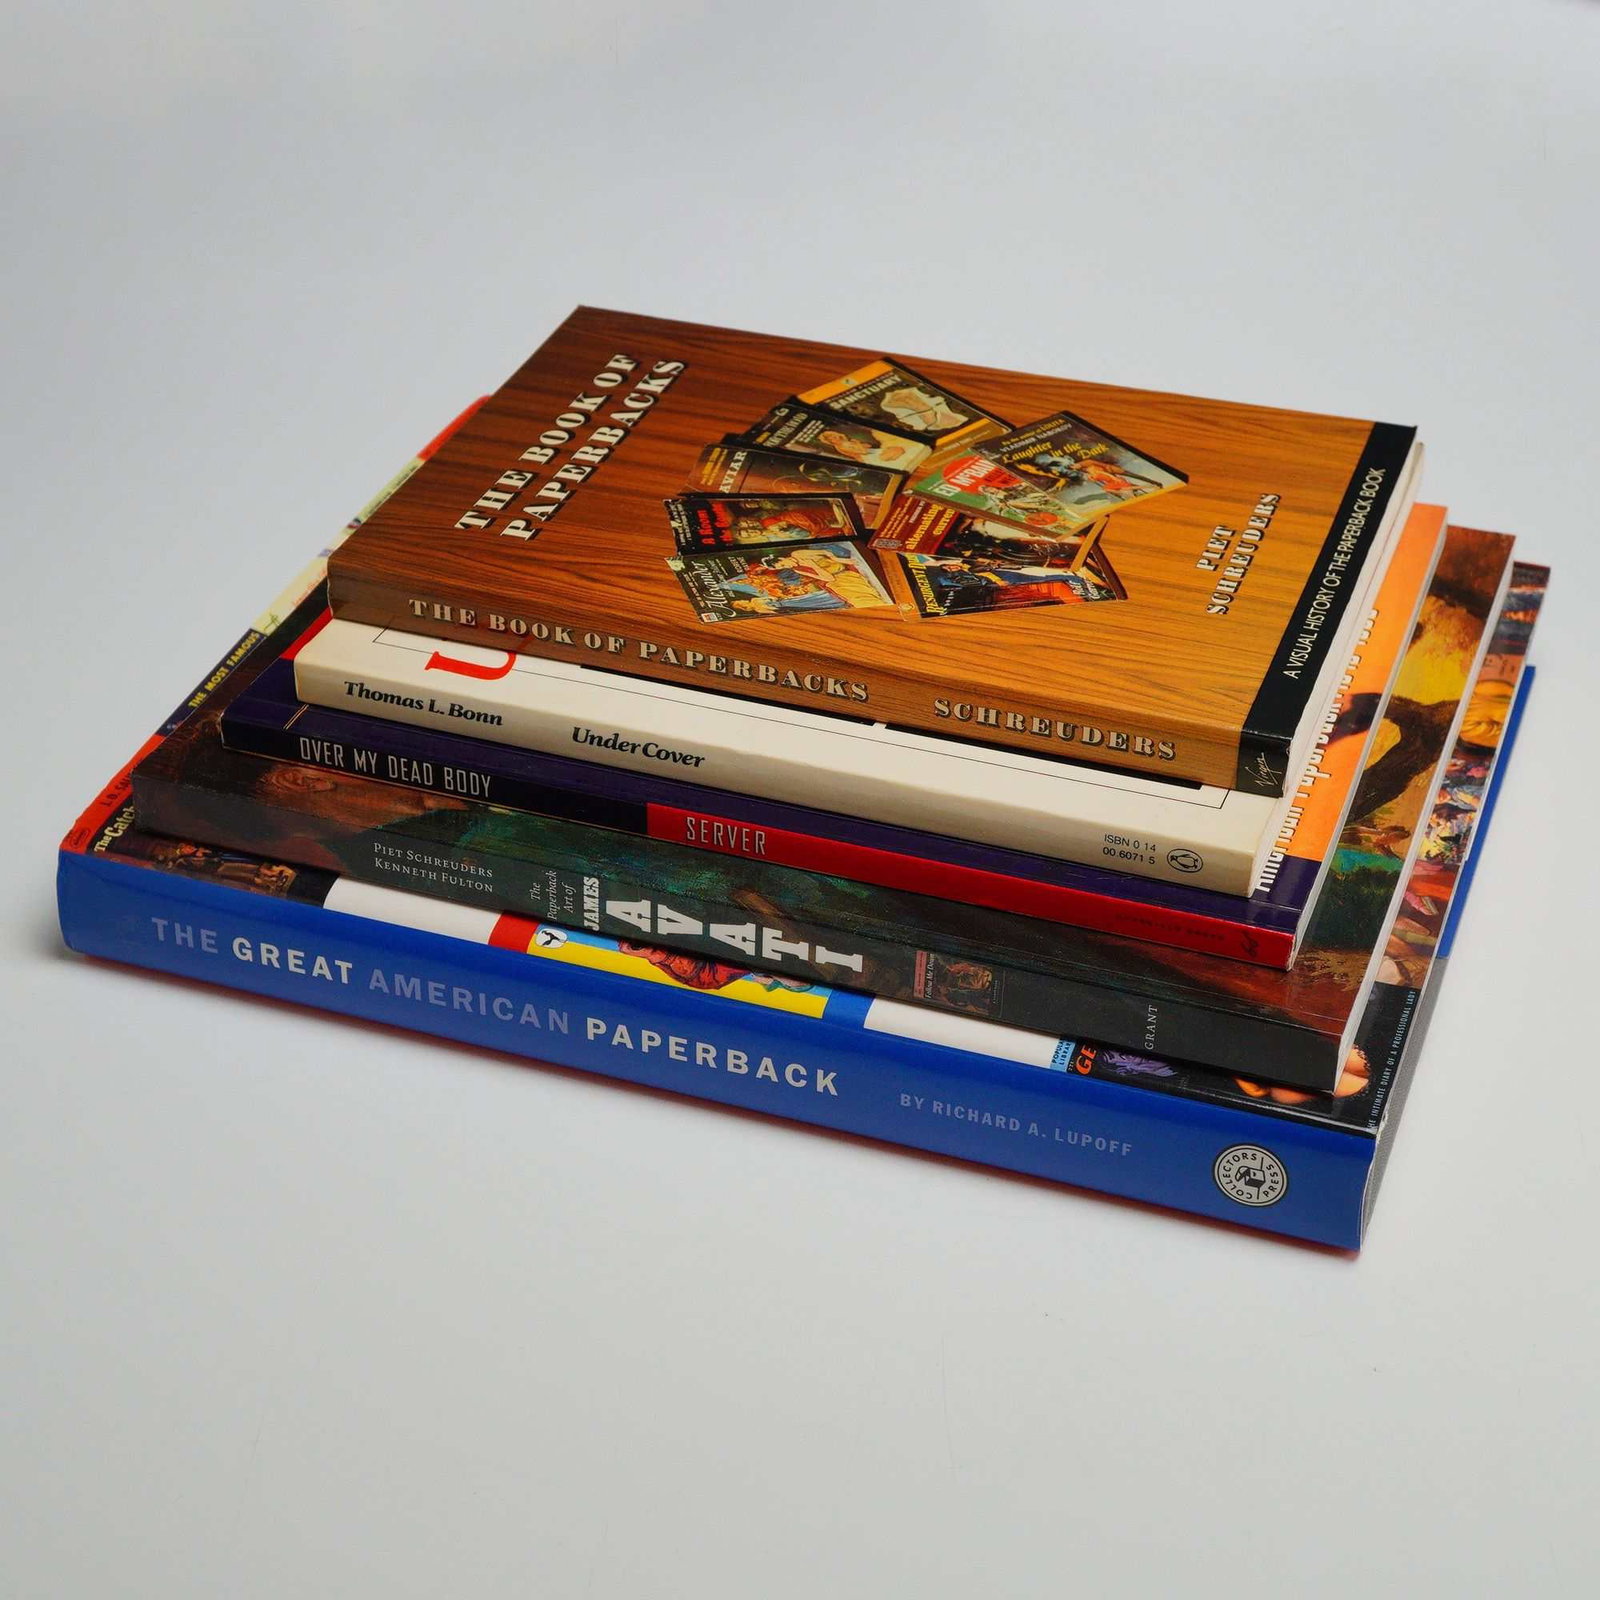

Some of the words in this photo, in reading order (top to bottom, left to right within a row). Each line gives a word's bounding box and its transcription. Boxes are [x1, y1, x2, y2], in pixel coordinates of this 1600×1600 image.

[829, 374, 902, 410] SANCTUARY
[454, 469, 534, 531] THE
[519, 392, 607, 465] BOOK
[592, 353, 641, 388] OF
[500, 359, 688, 541] PAPERBACKS
[1001, 441, 1053, 464] Laughter
[1050, 448, 1064, 458] in
[1063, 442, 1082, 454] the
[1077, 442, 1110, 460] Dark
[719, 451, 748, 494] AVIAR
[932, 483, 963, 497] ED
[1360, 467, 1387, 499] BOOK
[904, 503, 944, 551] alternating
[932, 508, 956, 536] curren
[1337, 499, 1371, 554] PAPERBACK
[1196, 525, 1237, 572] PIET
[1207, 493, 1281, 615] SCHREUDERS
[1328, 549, 1352, 574] THE
[691, 560, 737, 618] Alexander
[1322, 569, 1343, 588] OF
[1303, 586, 1336, 634] HISTORY
[188, 691, 209, 709] THE
[204, 666, 230, 692] MOST
[226, 631, 261, 667] FAMOUS
[1283, 669, 1301, 680] A
[1287, 632, 1317, 677] VISUAL
[408, 599, 478, 627] THE
[488, 613, 575, 646] BOOK
[584, 632, 628, 654] OF
[639, 642, 870, 702] PAPERBACKS
[934, 698, 1178, 761] SCHREUDERS
[343, 681, 424, 710] Thomas
[428, 698, 445, 715] L.
[449, 703, 503, 726] Bonn
[299, 737, 345, 768] OVER
[353, 748, 378, 775] MY
[388, 755, 434, 786] DEAD
[444, 766, 491, 798] BODY
[94, 835, 112, 852] The
[104, 806, 136, 837] Catch
[686, 816, 767, 855] SERVER
[1104, 834, 1130, 847] ISBN
[1133, 840, 1140, 849] 0
[1144, 843, 1156, 852] 14
[374, 842, 403, 858] PIET
[406, 850, 493, 878] SCHREUDERS
[374, 857, 437, 881] KENNETH
[441, 871, 493, 893] FULTON
[1102, 847, 1116, 857] 00
[1119, 850, 1144, 862] 6071
[1148, 856, 1155, 865] 5
[530, 882, 541, 901] The
[546, 870, 558, 920] Paperback
[562, 896, 574, 913] Art
[565, 884, 577, 896] of
[583, 876, 601, 931] JAMES
[605, 899, 864, 973] AVATI
[151, 917, 219, 954] THE
[231, 936, 353, 985] GREAT
[368, 968, 569, 1034] AMERICAN
[586, 1017, 839, 1097] PAPERBACK
[1144, 1004, 1158, 1050] GRANT
[1392, 1007, 1412, 1050] PROFESSIONAL
[1051, 1041, 1064, 1064] POPULA
[1058, 1042, 1071, 1066] LIBRAR
[1386, 1056, 1396, 1066] OF
[1381, 1066, 1392, 1087] DIARY
[1370, 1088, 1386, 1120] INTIMATE
[900, 1092, 925, 1111] BY
[931, 1100, 1021, 1133] RICHARD
[1027, 1122, 1047, 1139] A.
[1054, 1127, 1134, 1158] LUPOFF
[1222, 1152, 1258, 1200] COLLECTORS
[1263, 1163, 1280, 1198] PRESS
